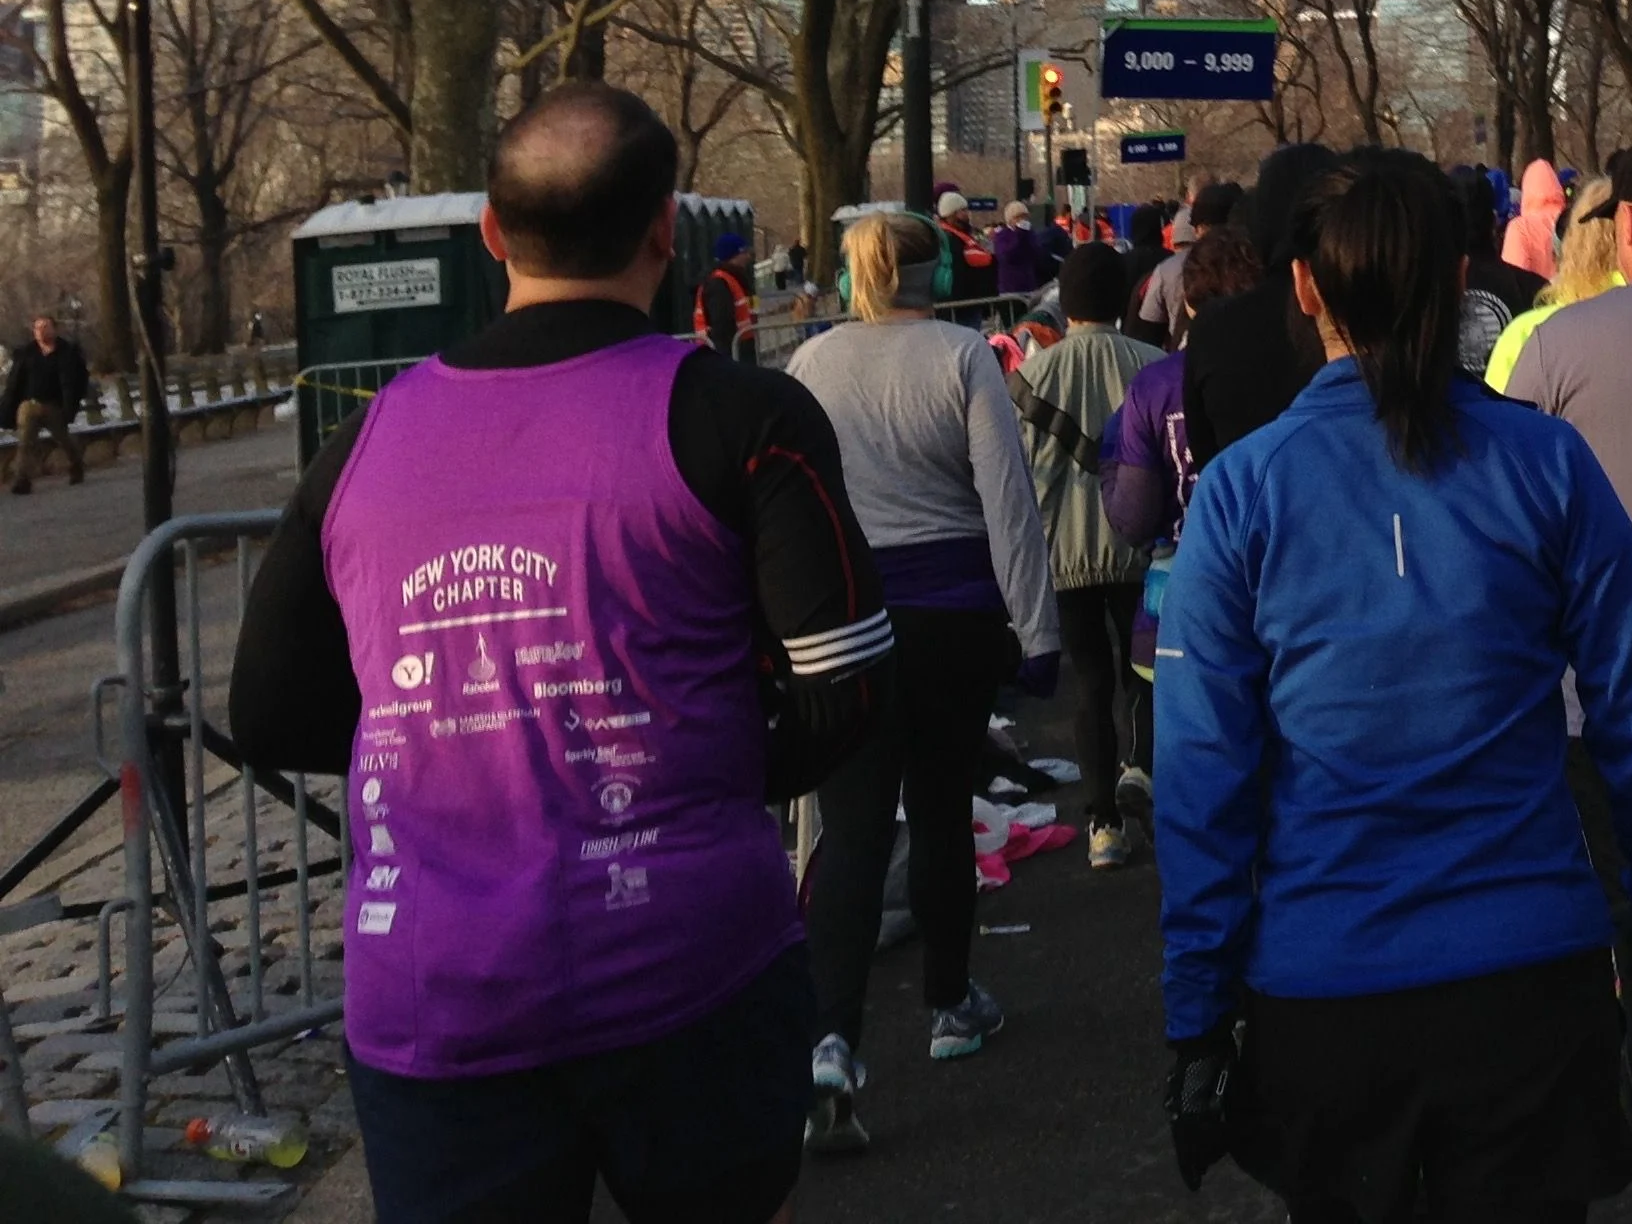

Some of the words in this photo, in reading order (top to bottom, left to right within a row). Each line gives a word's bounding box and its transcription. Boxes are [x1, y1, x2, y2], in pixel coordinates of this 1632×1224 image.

[1123, 50, 1175, 73] 9,000
[1203, 52, 1255, 74] 9,999
[337, 269, 375, 282] ROYAL
[378, 264, 415, 279] FLUSH
[401, 554, 445, 607] NEW
[449, 543, 506, 578] YORK
[510, 545, 558, 588] CITY
[432, 575, 525, 613] CHAPTER
[533, 677, 623, 700] Bloomberg
[580, 836, 619, 857] FINISH
[633, 827, 661, 849] LINE
